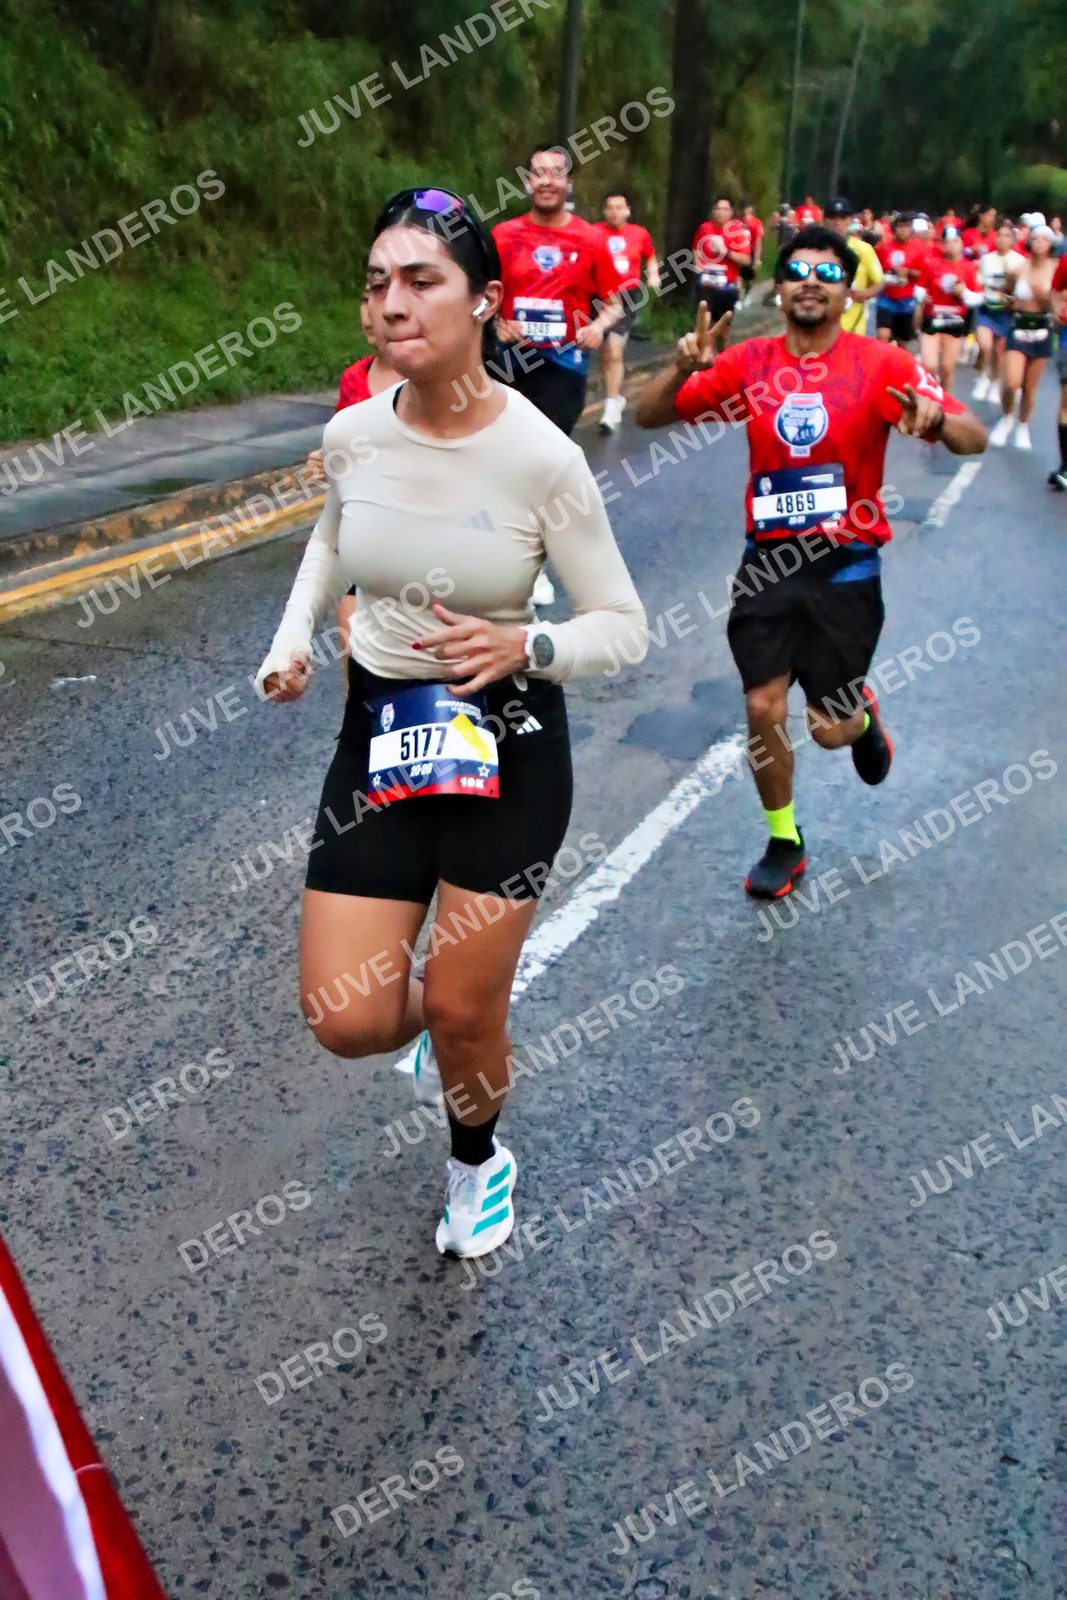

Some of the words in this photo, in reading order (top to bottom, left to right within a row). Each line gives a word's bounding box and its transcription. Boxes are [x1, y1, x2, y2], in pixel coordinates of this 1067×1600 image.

[776, 492, 816, 514] 4869
[401, 726, 448, 761] 5177
[461, 777, 484, 789] 10K
